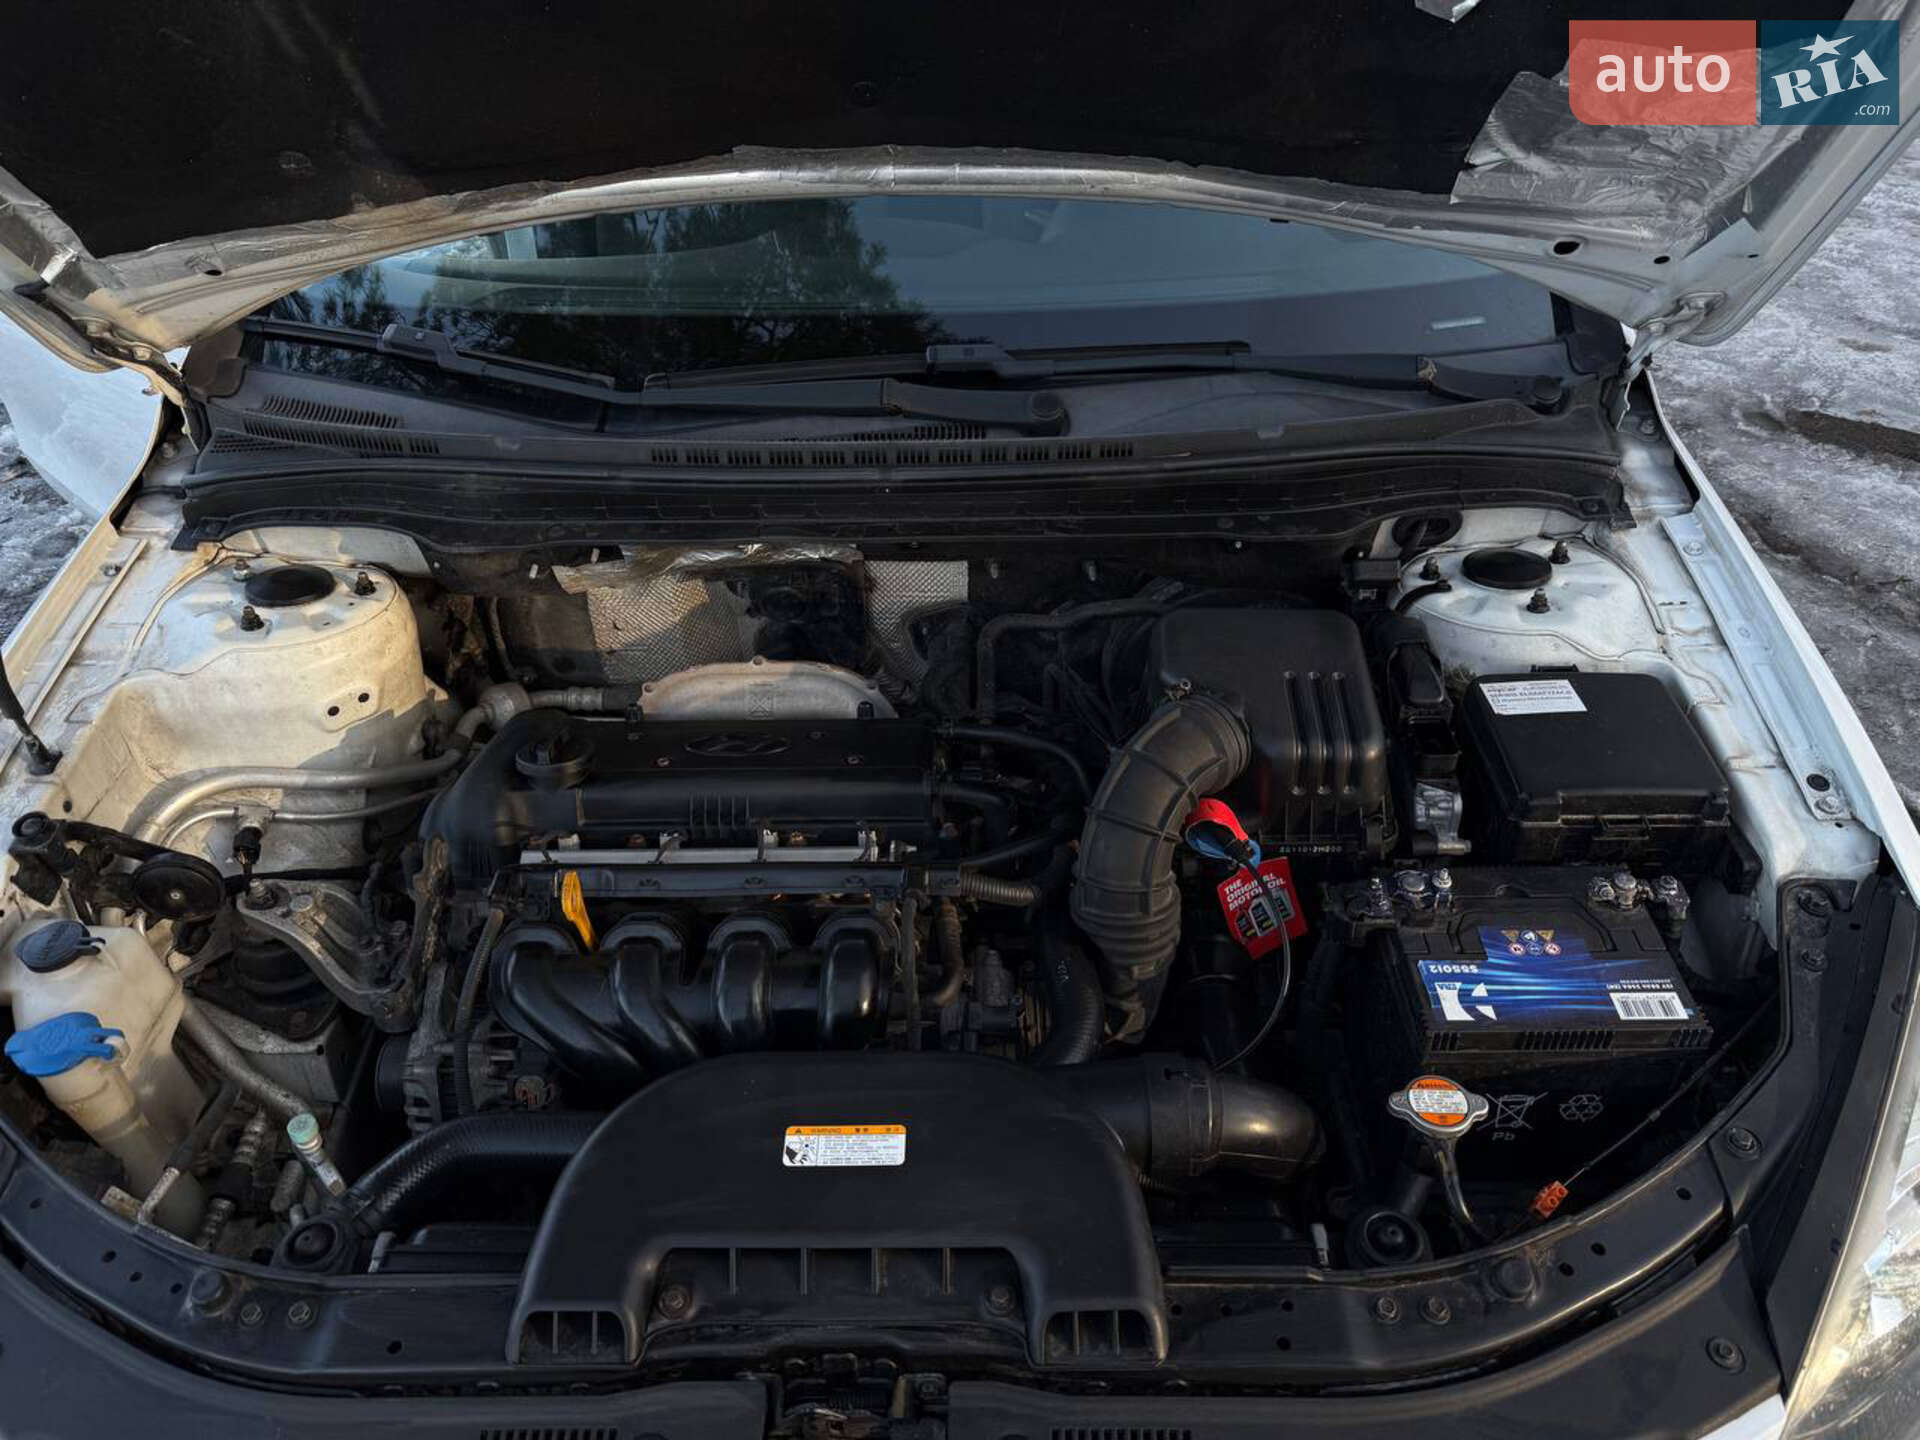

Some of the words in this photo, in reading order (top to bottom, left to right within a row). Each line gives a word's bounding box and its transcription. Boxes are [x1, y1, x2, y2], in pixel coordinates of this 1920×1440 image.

[1223, 879, 1242, 895] THE
[1267, 878, 1286, 890] OIL
[1492, 1132, 1516, 1141] Pb
